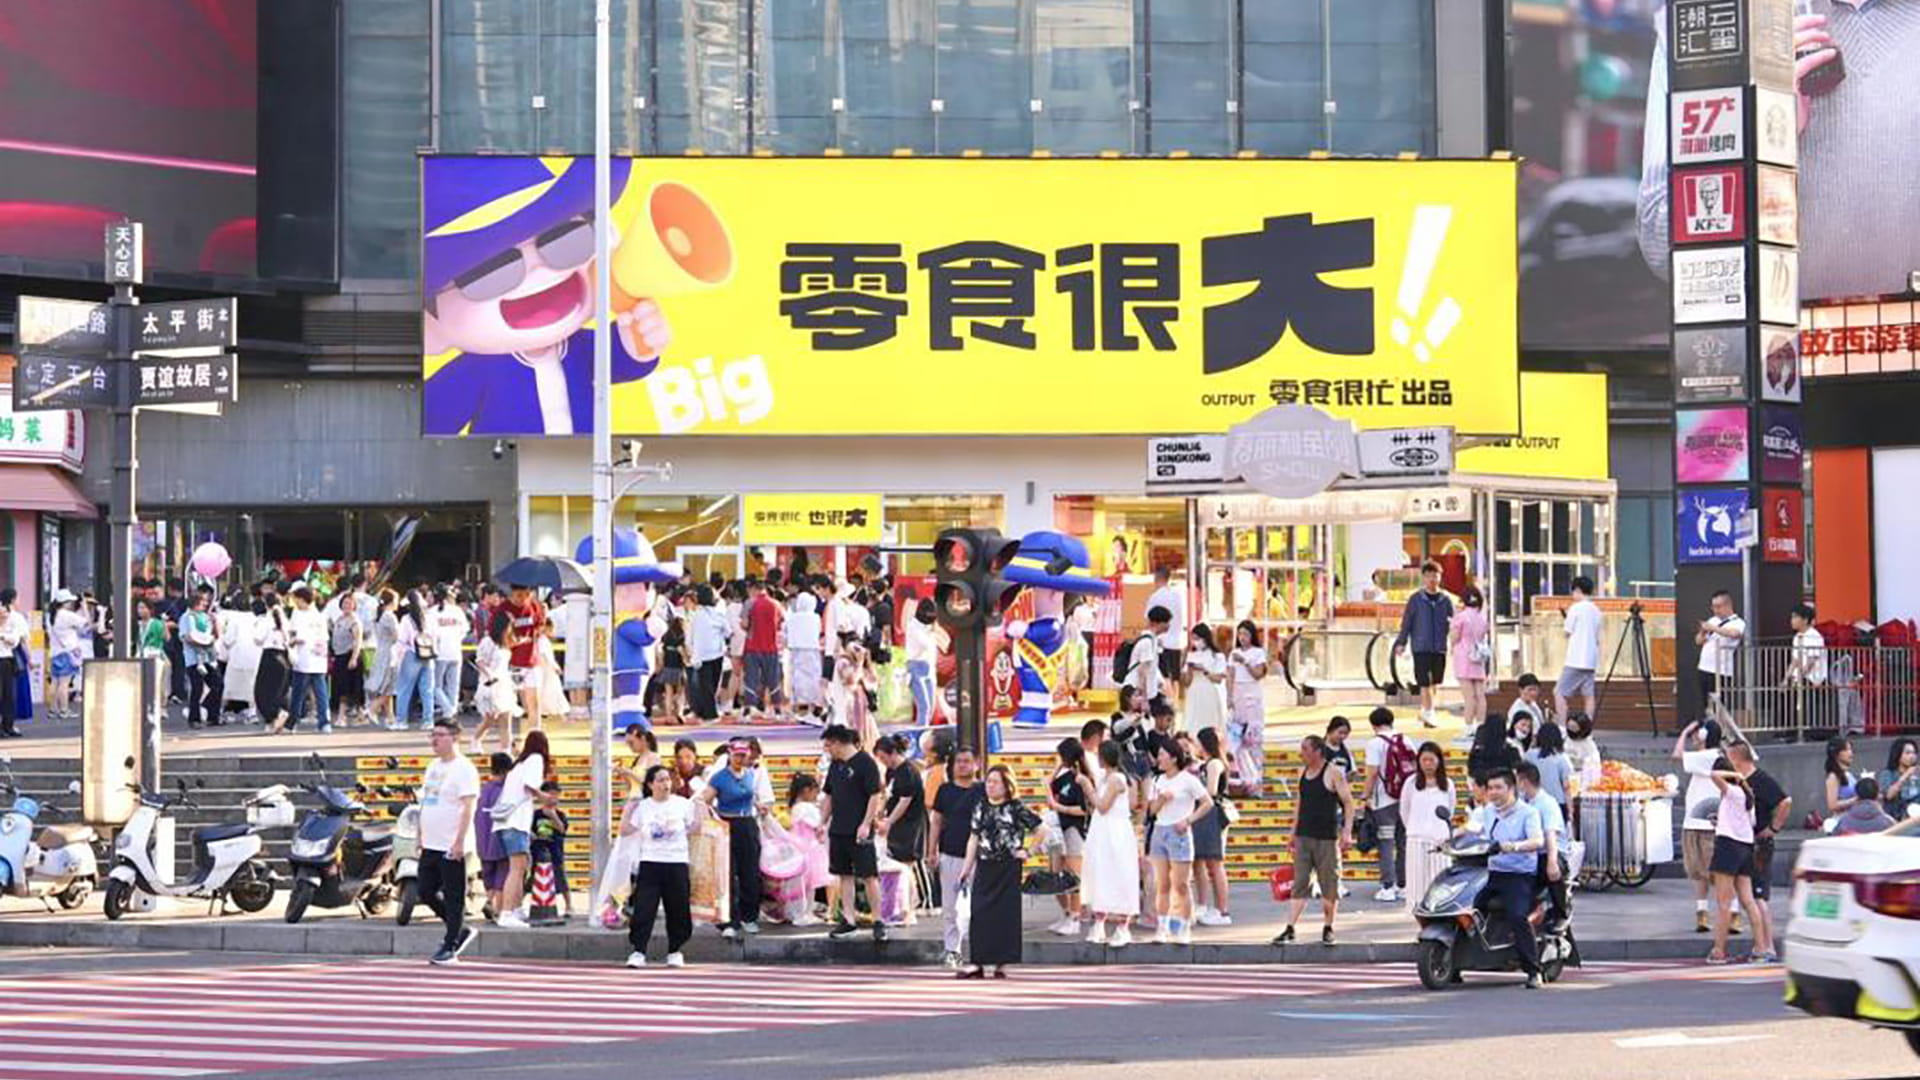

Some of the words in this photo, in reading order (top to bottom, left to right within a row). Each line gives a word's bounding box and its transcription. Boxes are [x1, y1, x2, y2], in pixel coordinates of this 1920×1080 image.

[1694, 217, 1727, 232] KFC
[115, 226, 131, 277] 天心区
[142, 308, 214, 335] 太平街
[40, 360, 107, 390] 定王台
[140, 363, 212, 391] 贾谊故居
[646, 354, 775, 435] Big
[1202, 393, 1256, 406] OUTPUT
[1401, 379, 1453, 406] 出品
[1515, 436, 1561, 449] OUTPUT
[1156, 452, 1212, 464] KINGKONG
